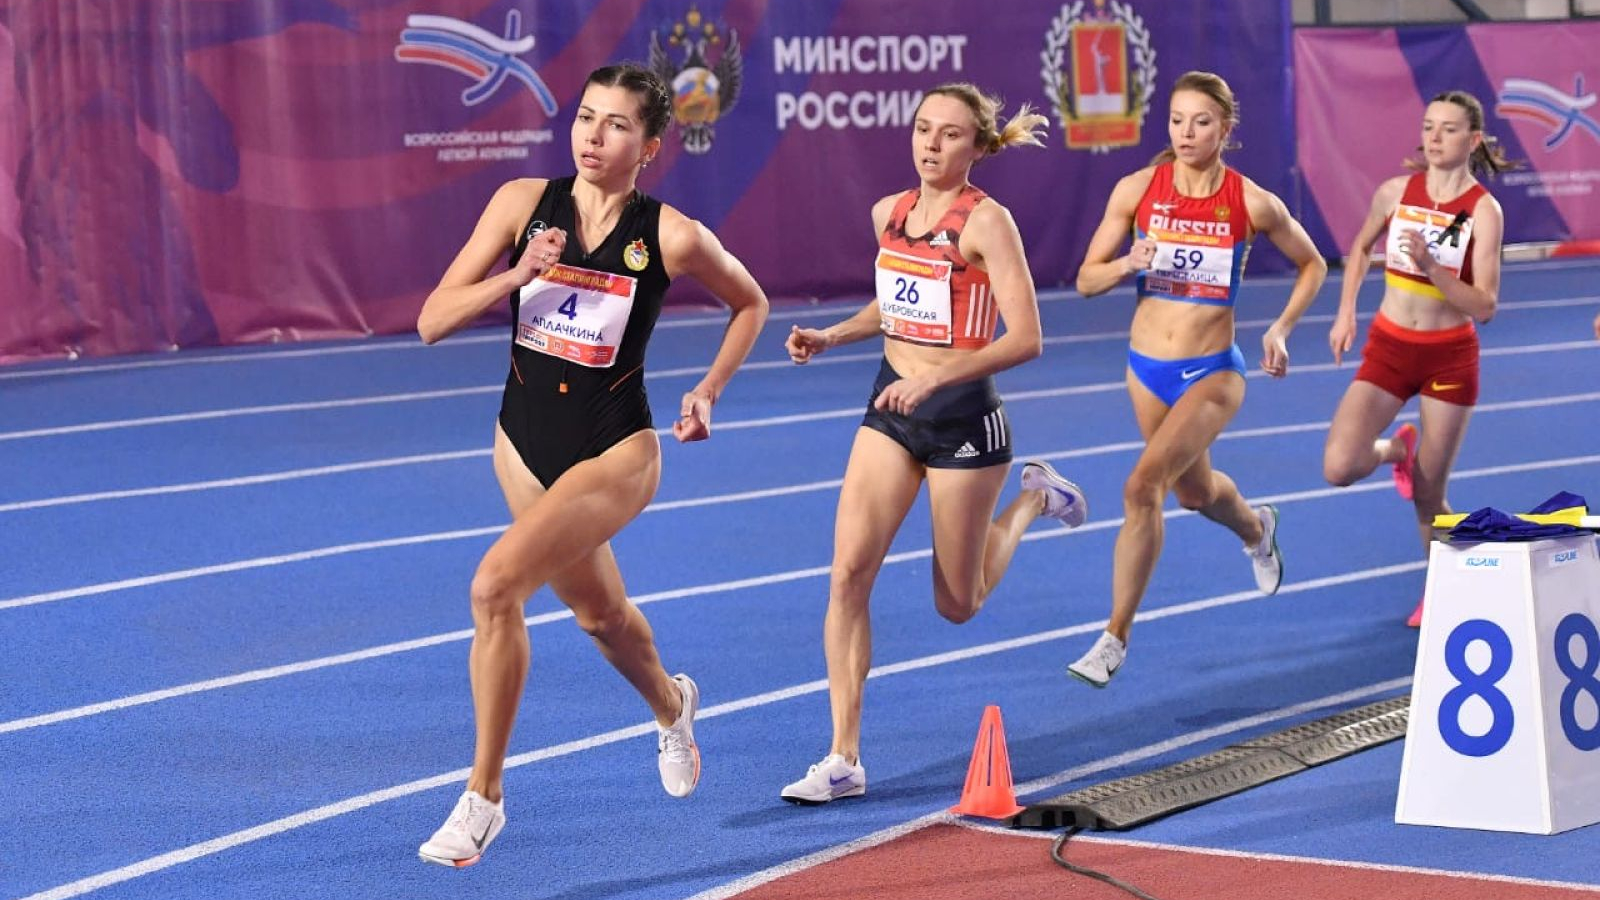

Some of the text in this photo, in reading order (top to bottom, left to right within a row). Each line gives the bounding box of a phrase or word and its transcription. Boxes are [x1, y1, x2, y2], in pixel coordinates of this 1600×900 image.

[774, 35, 967, 73] МИНСПОРТ
[776, 90, 923, 130] РОССИИ
[1172, 248, 1204, 270] 59
[558, 292, 578, 320] 4
[895, 277, 920, 305] 26
[532, 315, 604, 342] АПЛАЧКИНА
[1438, 619, 1515, 757] 8
[1554, 613, 1600, 751] 8
